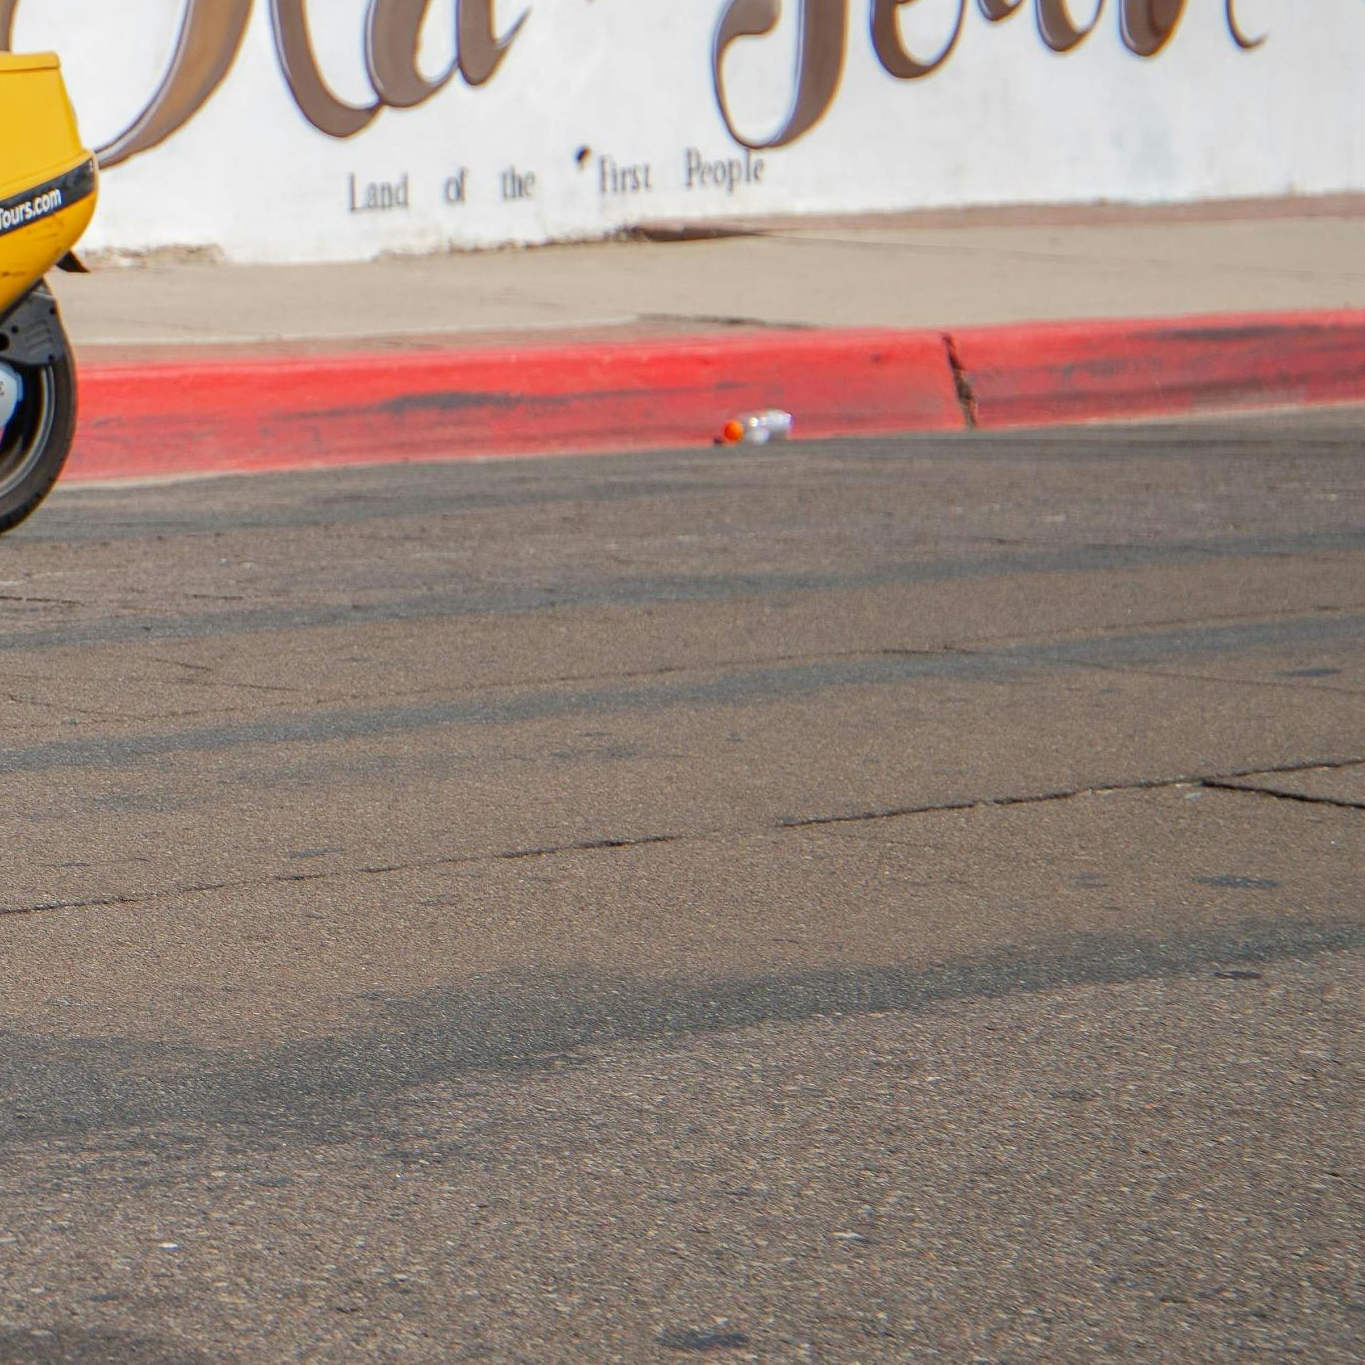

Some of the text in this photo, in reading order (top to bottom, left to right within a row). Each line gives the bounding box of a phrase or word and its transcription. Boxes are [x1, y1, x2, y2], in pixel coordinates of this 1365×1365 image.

[348, 146, 767, 212] Land of the First People
